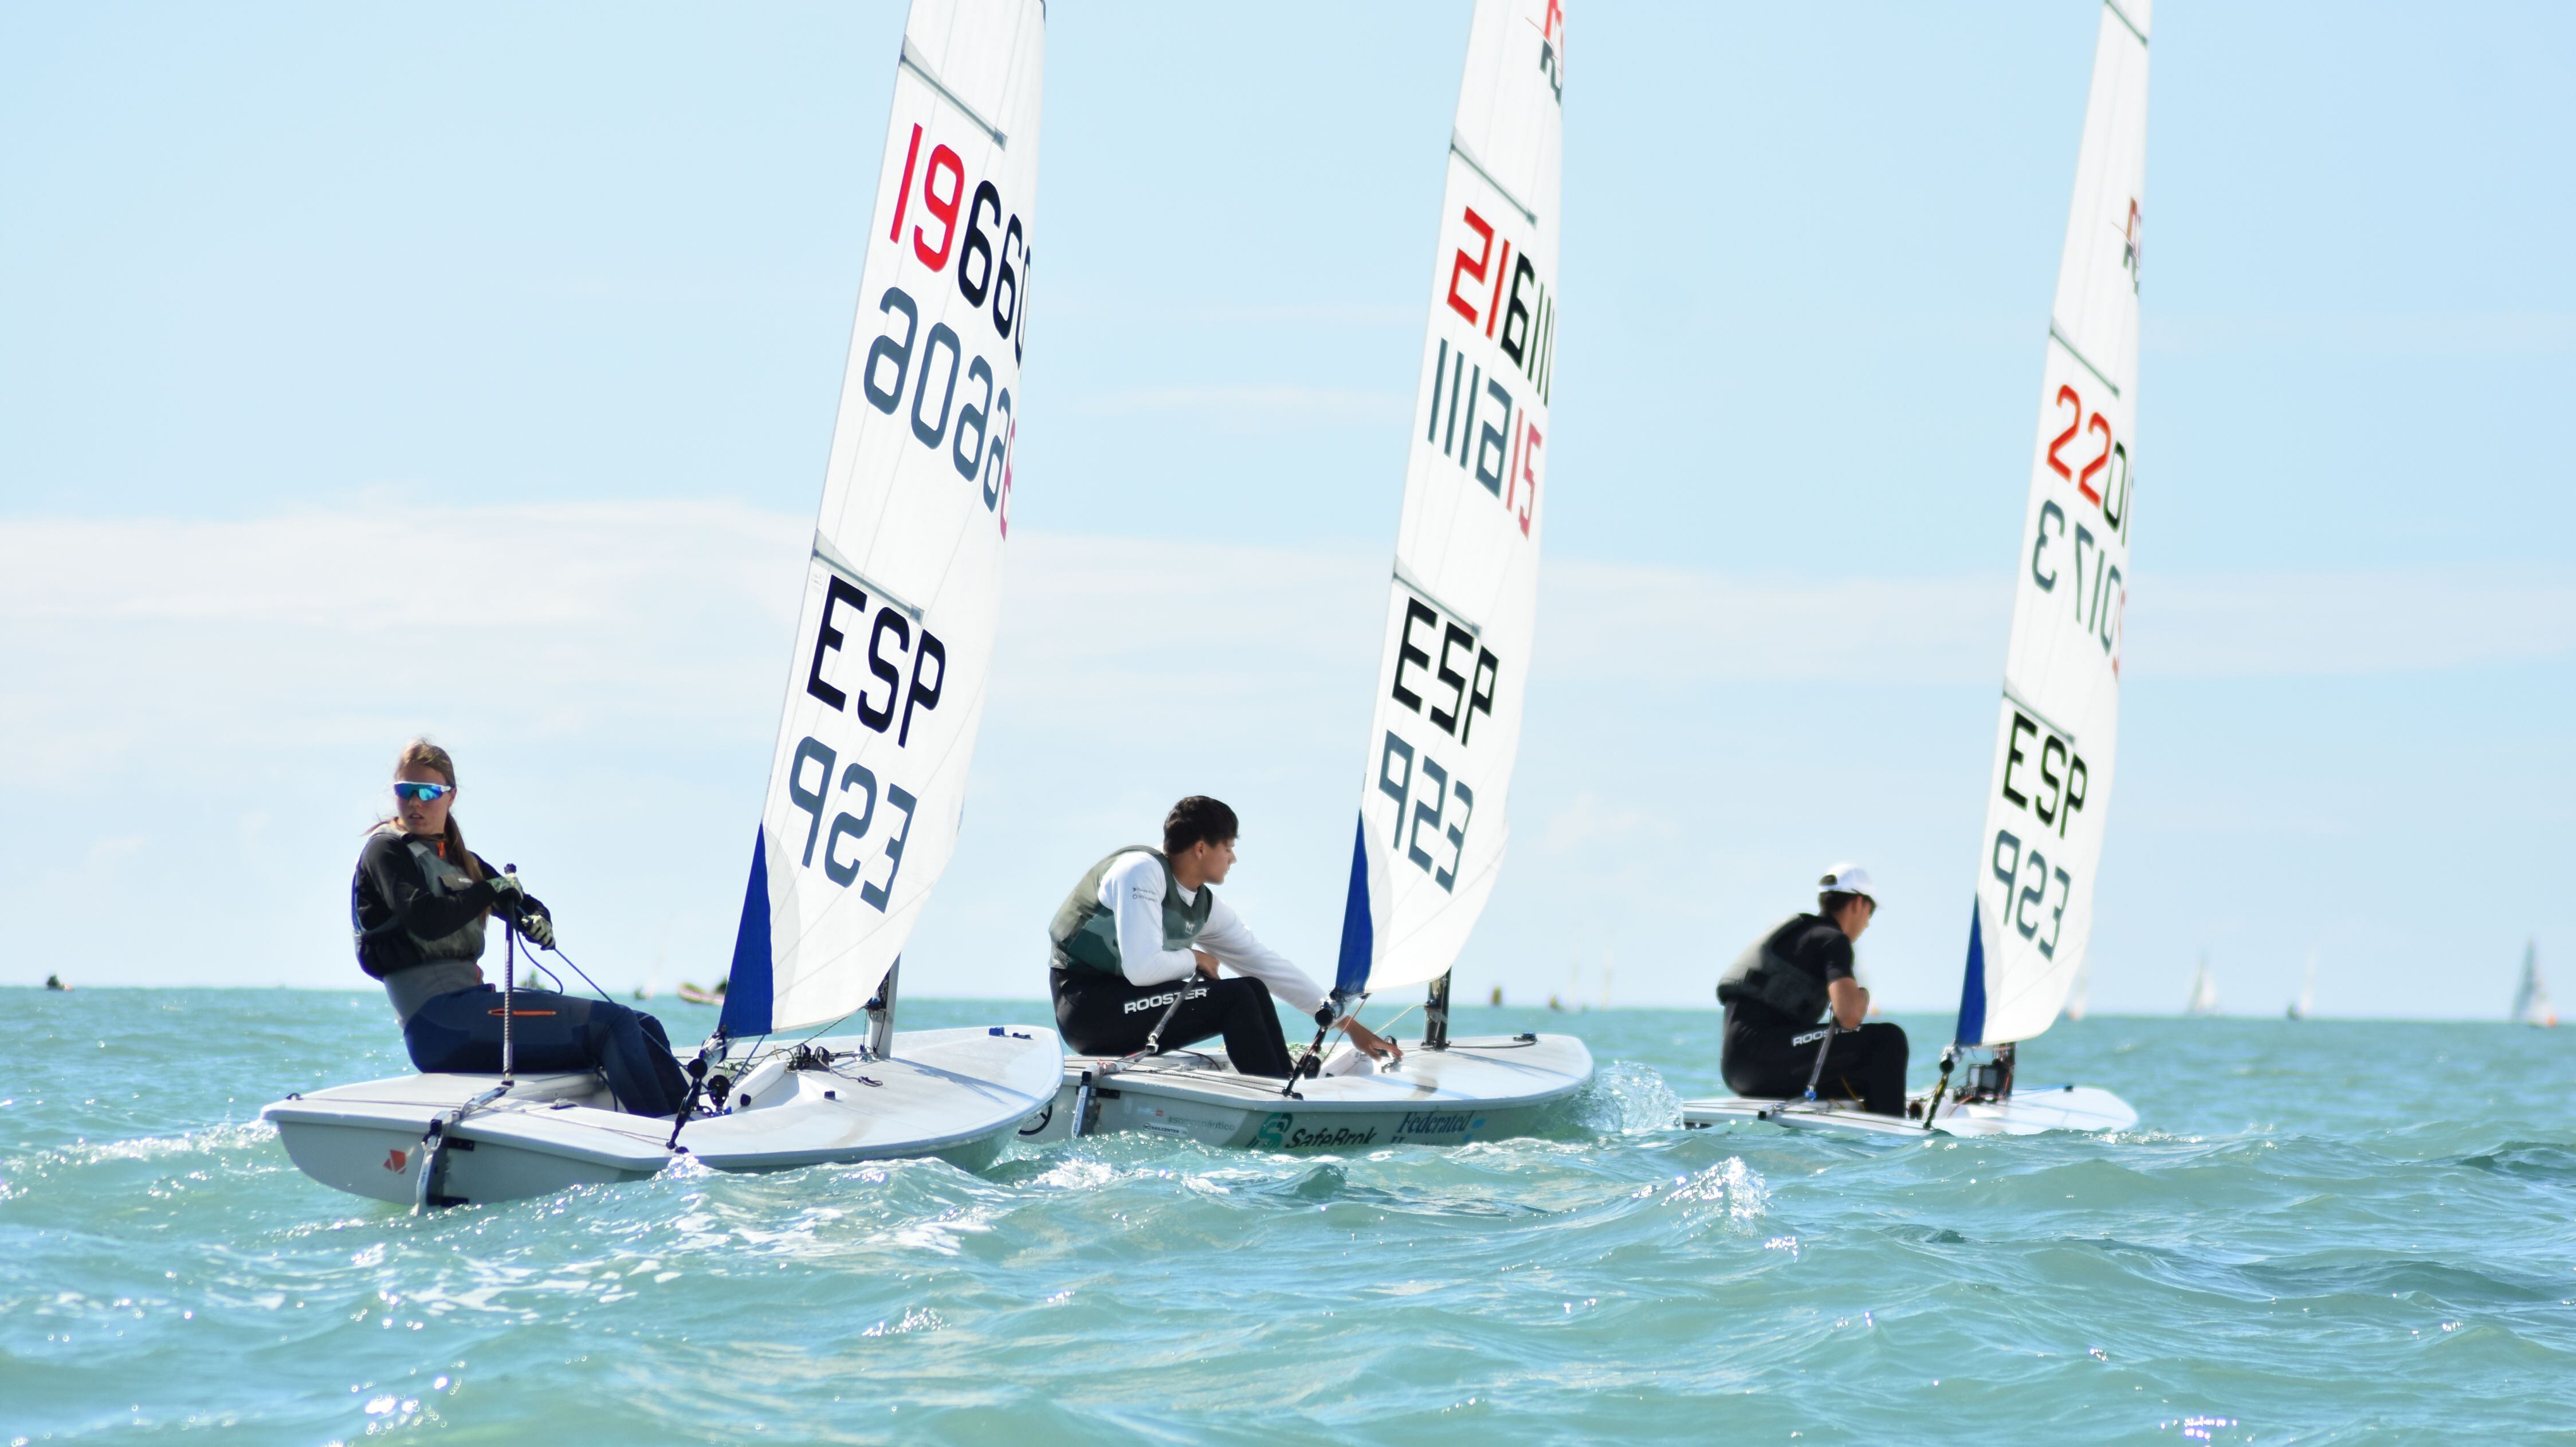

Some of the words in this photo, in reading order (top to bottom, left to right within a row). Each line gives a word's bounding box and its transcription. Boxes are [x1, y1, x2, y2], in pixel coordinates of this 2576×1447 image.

[1447, 205, 1555, 409] 216111
[807, 574, 946, 749] ESP
[1392, 596, 1499, 748] ESP
[2002, 710, 2087, 840] ESP
[1396, 1110, 1476, 1134] Federated
